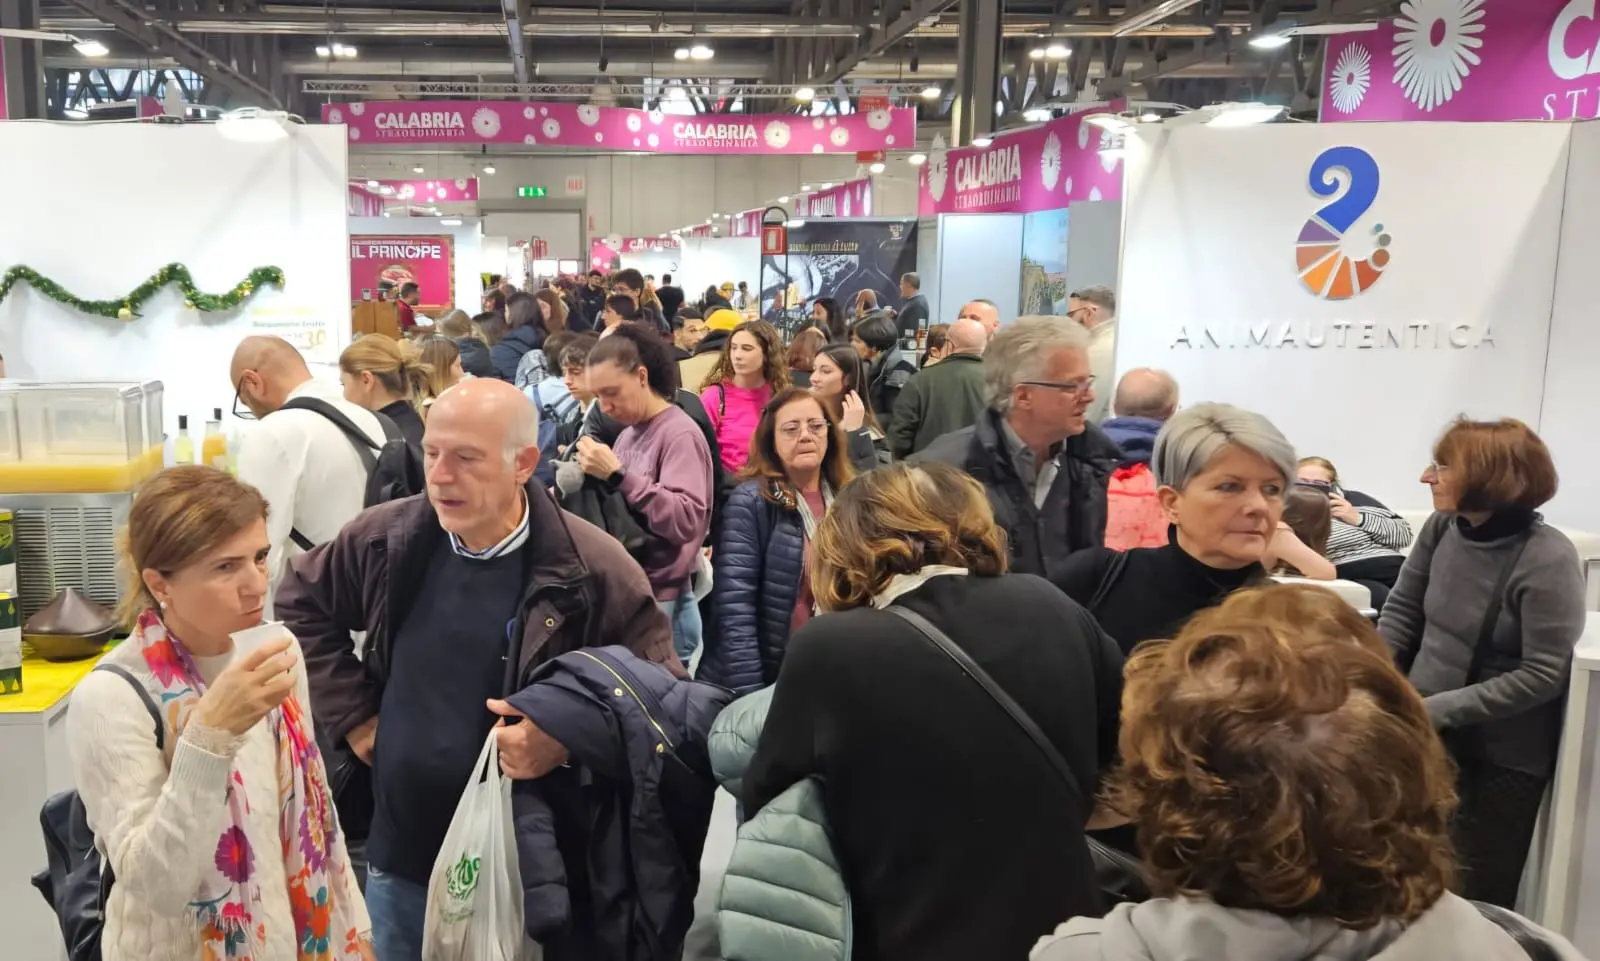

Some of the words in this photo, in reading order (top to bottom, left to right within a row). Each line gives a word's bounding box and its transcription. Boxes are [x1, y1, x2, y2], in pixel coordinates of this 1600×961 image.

[1548, 0, 1600, 80] C
[374, 112, 465, 129] CALABRIA
[672, 122, 758, 139] CALABRIA
[954, 144, 1022, 193] CALABRIA
[351, 245, 366, 258] IL
[369, 245, 441, 259] PRINCIPE
[1169, 320, 1497, 349] ANIMAUTENTICA
